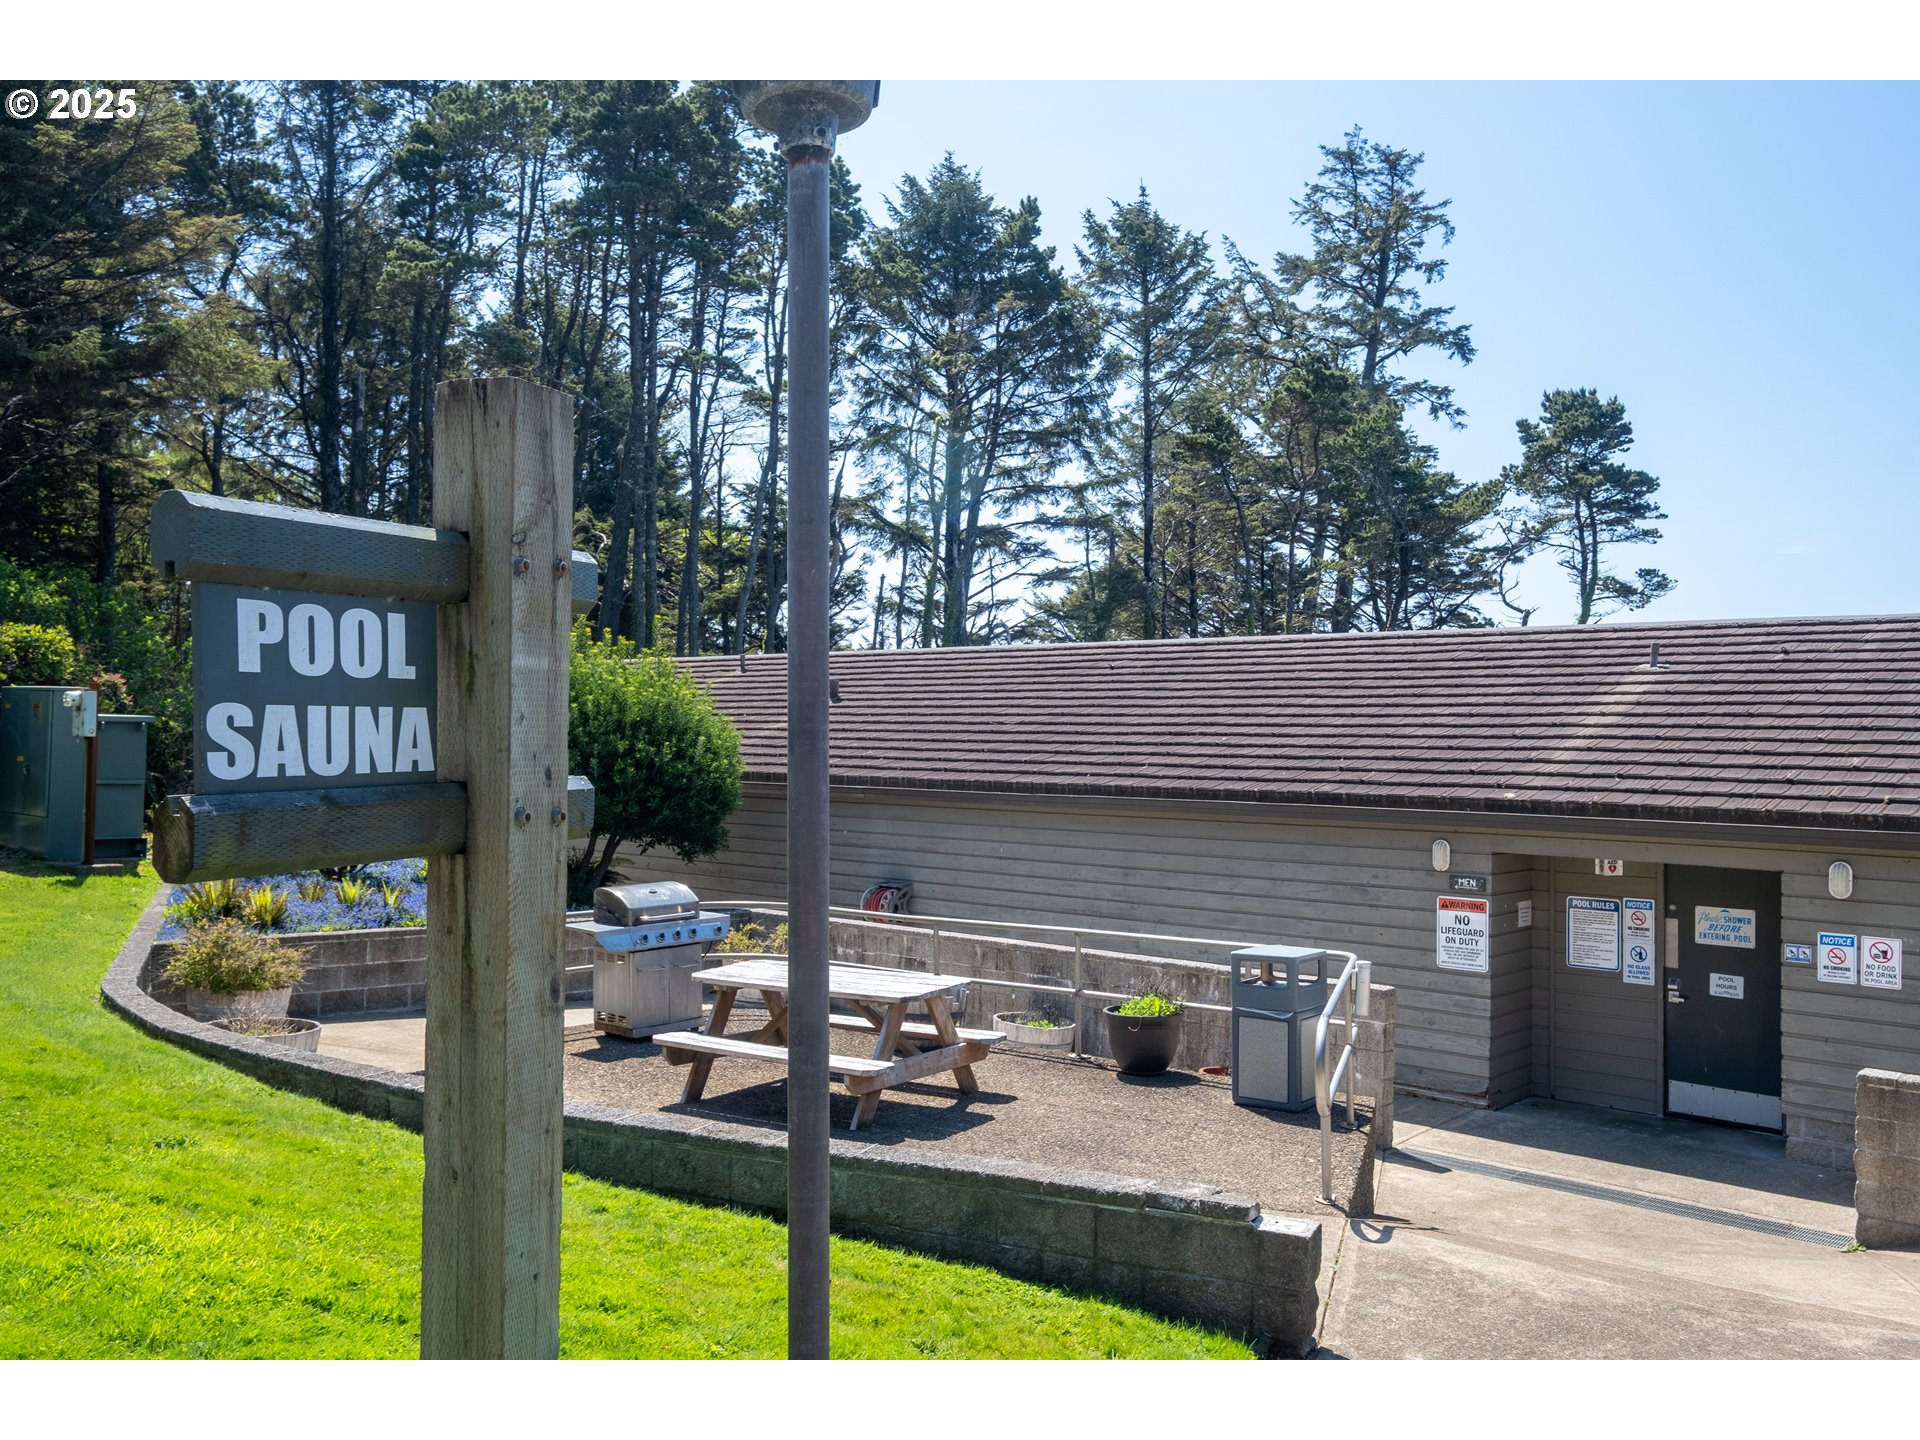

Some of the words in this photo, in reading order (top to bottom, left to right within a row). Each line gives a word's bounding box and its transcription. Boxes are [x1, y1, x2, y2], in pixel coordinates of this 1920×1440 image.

[236, 598, 417, 681] POOL
[206, 702, 435, 780] SAUNA
[1458, 879, 1476, 887] MEN
[1449, 901, 1485, 911] WARNING
[1572, 900, 1591, 908] POOL
[1592, 901, 1615, 910] RULES
[1626, 901, 1651, 909] NOTICE
[1455, 914, 1470, 926] NO
[1723, 915, 1752, 925] SHOWER
[1440, 926, 1485, 938] LIFEGUARD
[1708, 923, 1744, 933] BEFORE
[1445, 936, 1456, 944] ON
[1458, 937, 1480, 946] DUTY
[1699, 932, 1731, 941] ENTERING
[1734, 935, 1752, 943] POOL
[1822, 936, 1852, 945] NOTICE
[1877, 964, 1897, 972] FOOD
